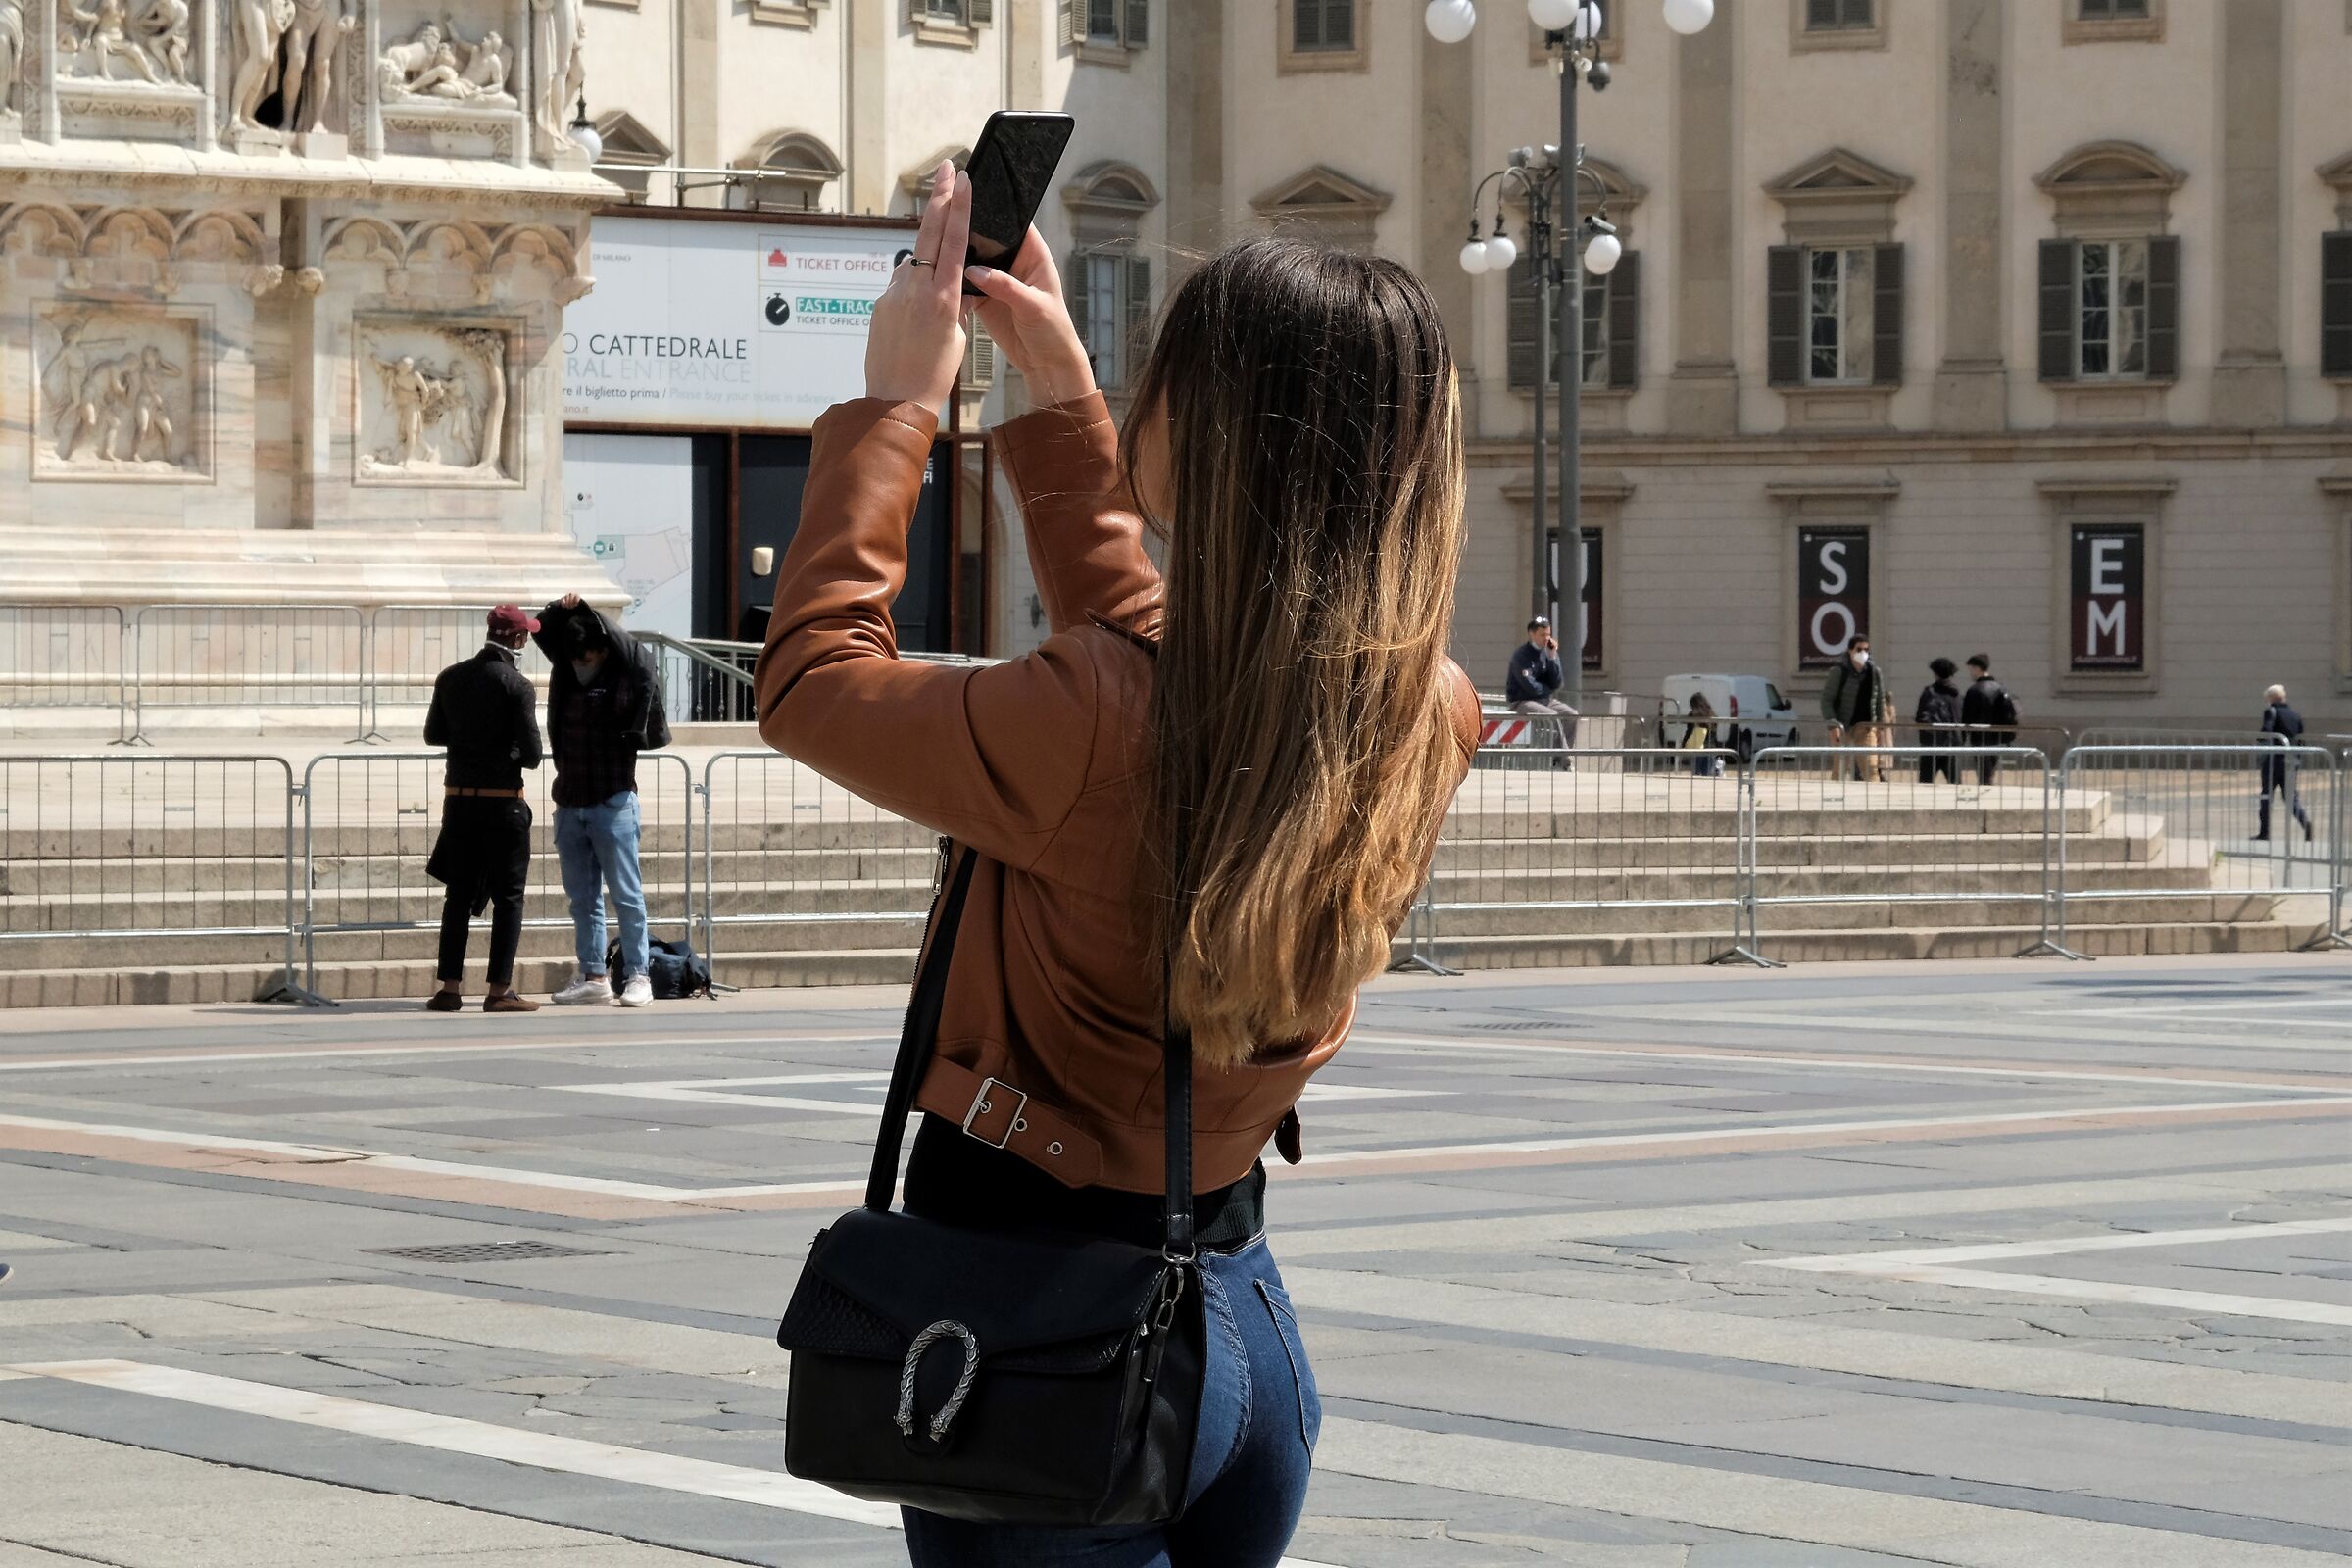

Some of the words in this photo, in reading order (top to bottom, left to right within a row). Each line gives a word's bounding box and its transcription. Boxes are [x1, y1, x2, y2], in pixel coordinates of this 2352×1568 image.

[796, 257, 840, 270] TICKET
[844, 260, 887, 272] OFFICE
[797, 316, 826, 325] TICKET
[830, 317, 859, 326] OFFICE
[589, 334, 747, 360] CATTEDRALE
[564, 358, 612, 379] RAL
[620, 358, 751, 383] ENTRANCE
[576, 386, 582, 396] il
[585, 386, 627, 400] biglietto
[630, 389, 660, 400] prima
[703, 388, 722, 403] buy
[725, 392, 750, 405] your
[1819, 540, 1848, 595] S
[2090, 538, 2125, 595] E
[1811, 601, 1855, 656] O
[2087, 599, 2126, 656] M
